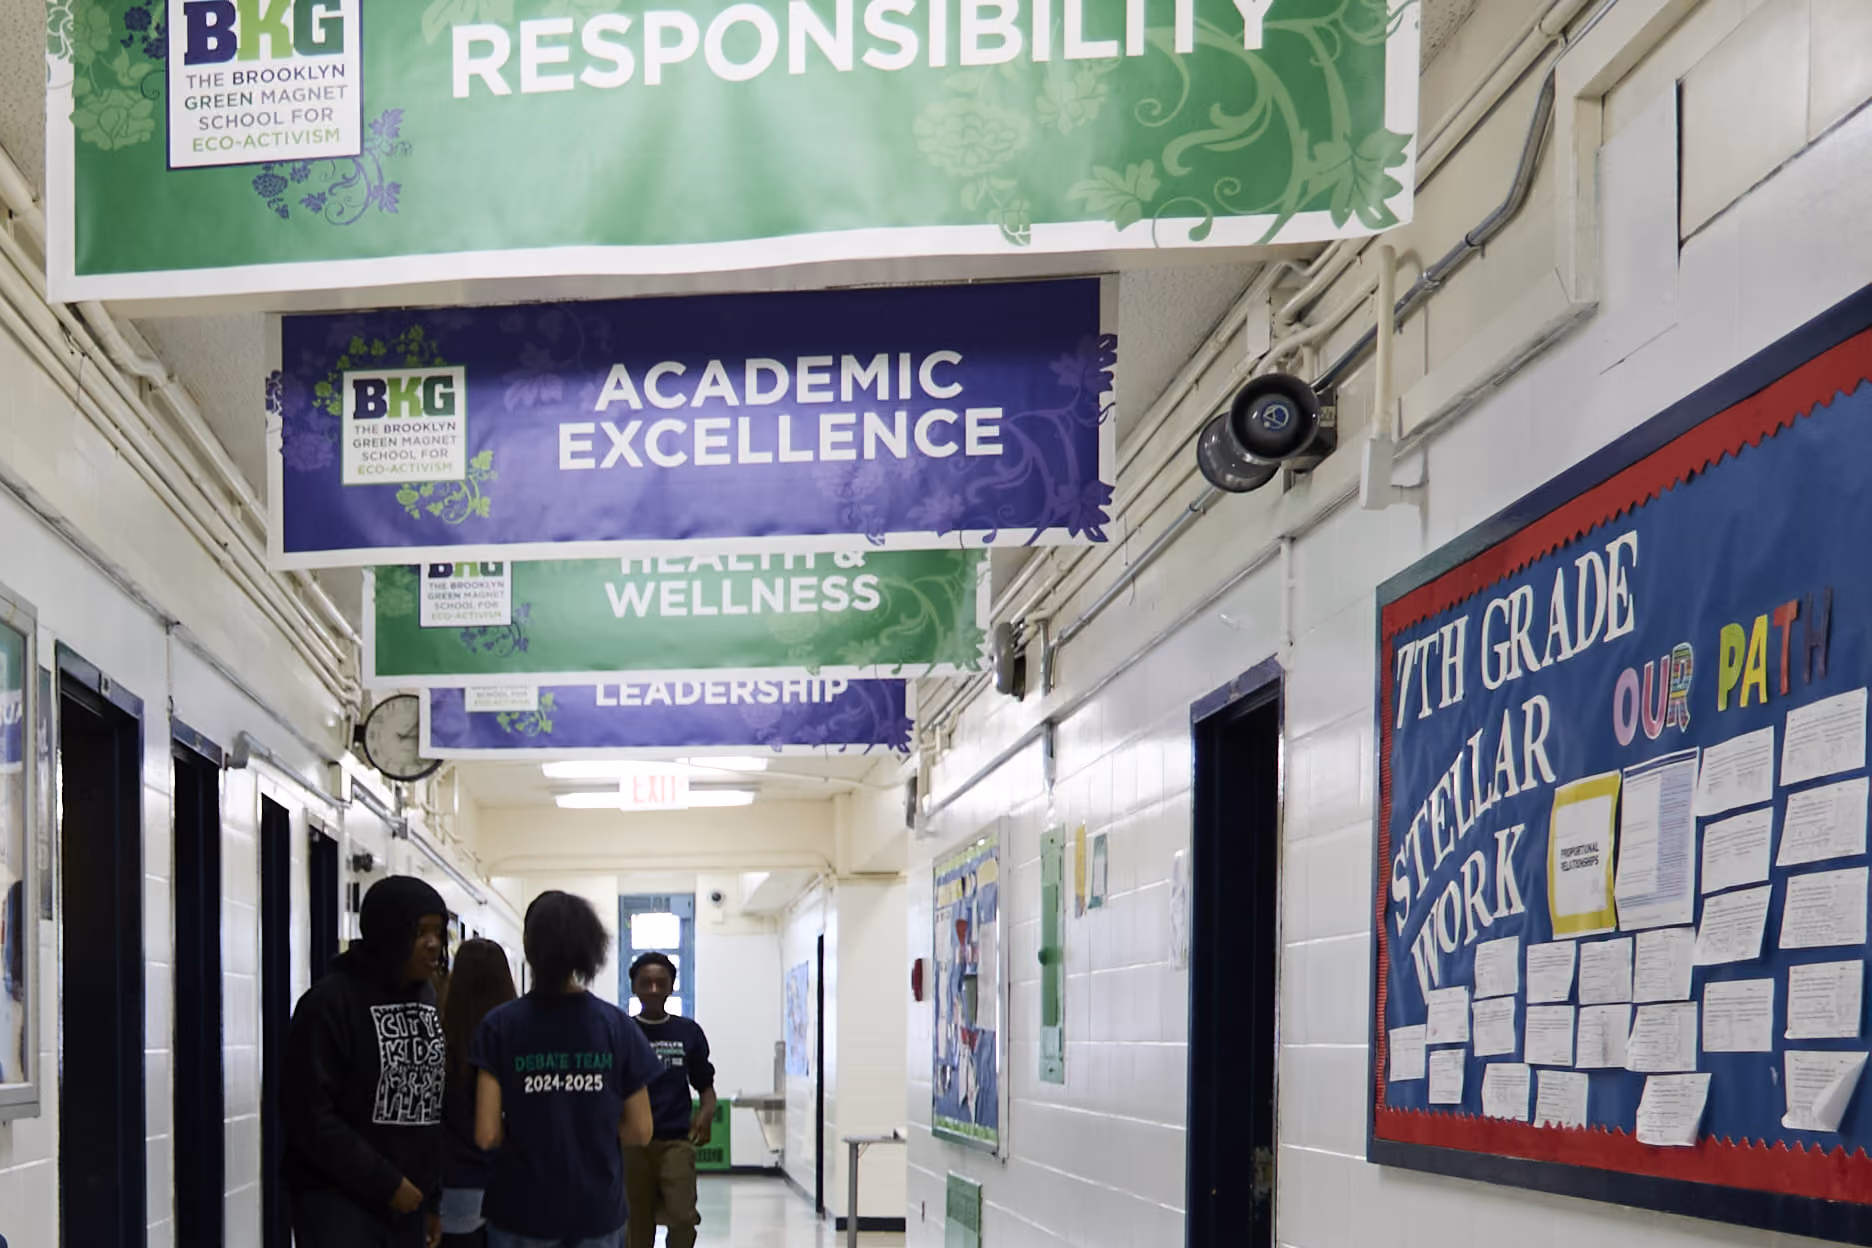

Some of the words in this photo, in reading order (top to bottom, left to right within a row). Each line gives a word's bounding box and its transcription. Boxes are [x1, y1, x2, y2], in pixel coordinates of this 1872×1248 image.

[184, 0, 344, 66] BKG
[186, 72, 224, 89] THE
[232, 63, 345, 85] BROOKLYN
[184, 91, 253, 110] GREEN
[261, 84, 348, 104] MAGNET
[199, 111, 284, 130] SCHOOL
[291, 107, 334, 124] FOR
[192, 127, 340, 152] ECO-ACTIVISM
[594, 350, 963, 411] ACADEMIC
[353, 375, 455, 420] BKG
[355, 424, 379, 435] THE
[384, 421, 456, 434] BROOKLYN
[559, 407, 1003, 470] EXCELLENCE
[353, 437, 397, 448] GREEN
[402, 435, 457, 447] MAGNET
[362, 450, 416, 461] SCHOOL
[421, 448, 448, 459] FOR
[604, 574, 881, 618] WELLNESS
[1396, 615, 1469, 729] 7TH
[1481, 530, 1638, 690] GRADE
[1613, 641, 1694, 747] OUR
[1717, 585, 1832, 712] PATH
[595, 677, 849, 706] LEADERSHIP
[1390, 694, 1556, 937] STELLAR
[1410, 823, 1526, 1006] WORK
[381, 1012, 435, 1038] CITY
[385, 1038, 444, 1064] KIDS
[514, 1053, 569, 1072] DEBATE
[574, 1052, 613, 1071] TEAM
[524, 1073, 604, 1094] 2024-2025
